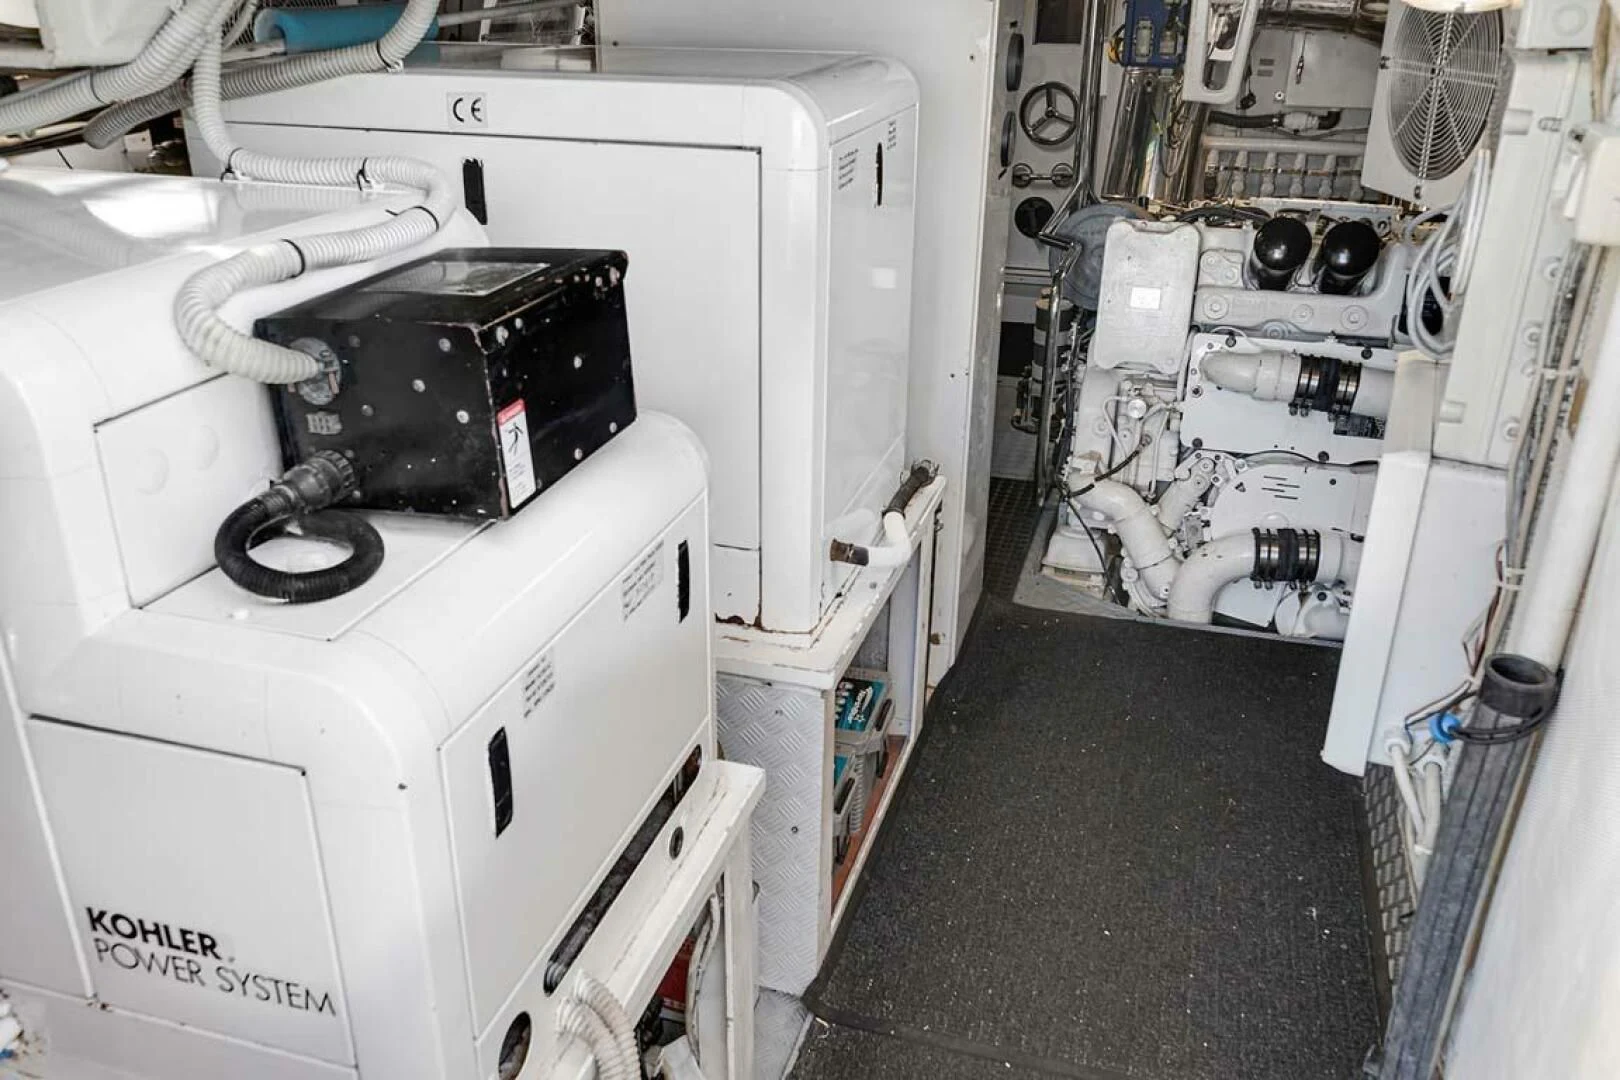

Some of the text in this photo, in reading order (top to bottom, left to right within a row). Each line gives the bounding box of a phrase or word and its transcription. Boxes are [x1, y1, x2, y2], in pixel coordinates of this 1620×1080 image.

[452, 97, 482, 123] CE
[86, 906, 222, 961] KOHLER
[94, 937, 336, 1016] POWER SYSTEM
